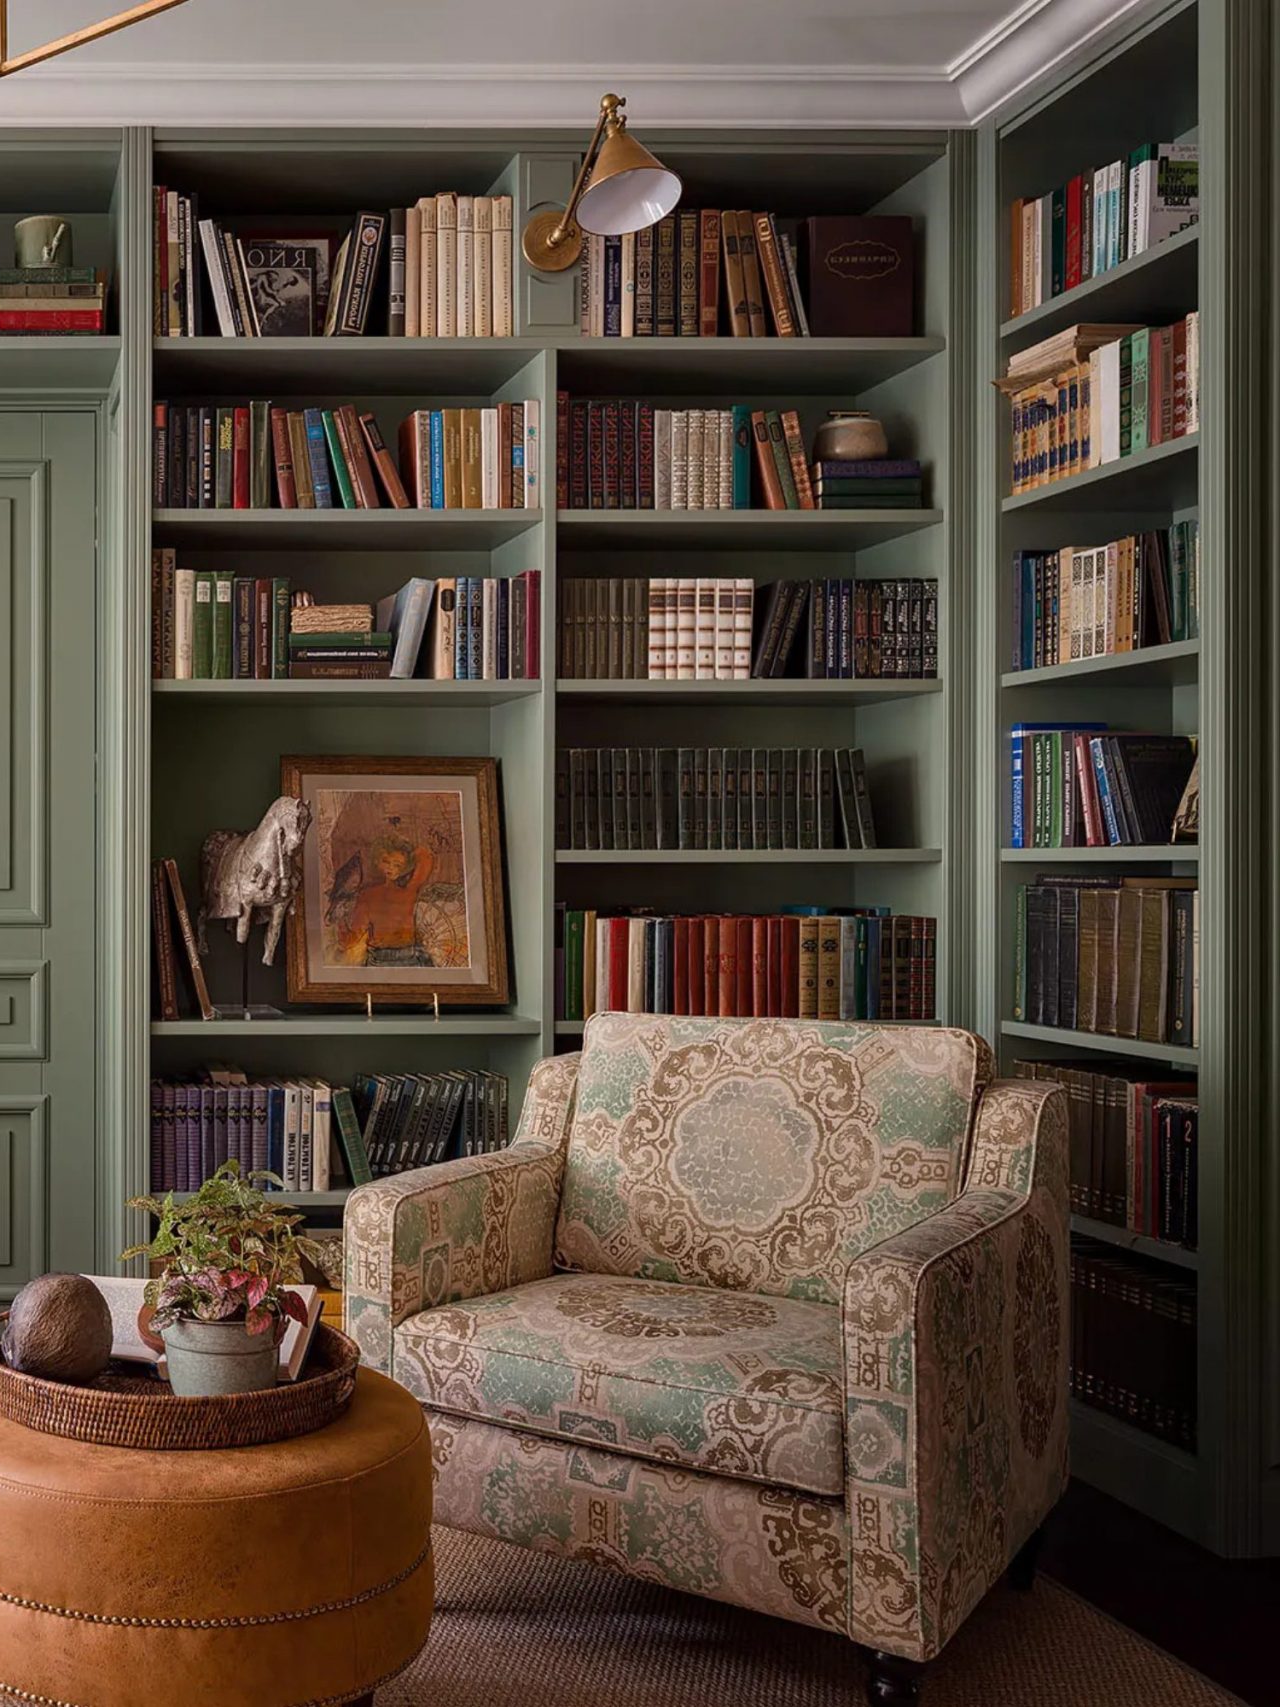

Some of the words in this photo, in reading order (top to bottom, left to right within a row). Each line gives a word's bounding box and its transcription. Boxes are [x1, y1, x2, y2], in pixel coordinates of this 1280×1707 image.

[247, 248, 306, 267] ОЙЯ
[591, 408, 602, 492] ШЕКСПИР
[607, 408, 618, 492] ШЕКСПИР
[623, 408, 634, 492] ШЕКСПИР
[640, 408, 652, 492] ШЕКСПИР
[1184, 1120, 1192, 1142] 2
